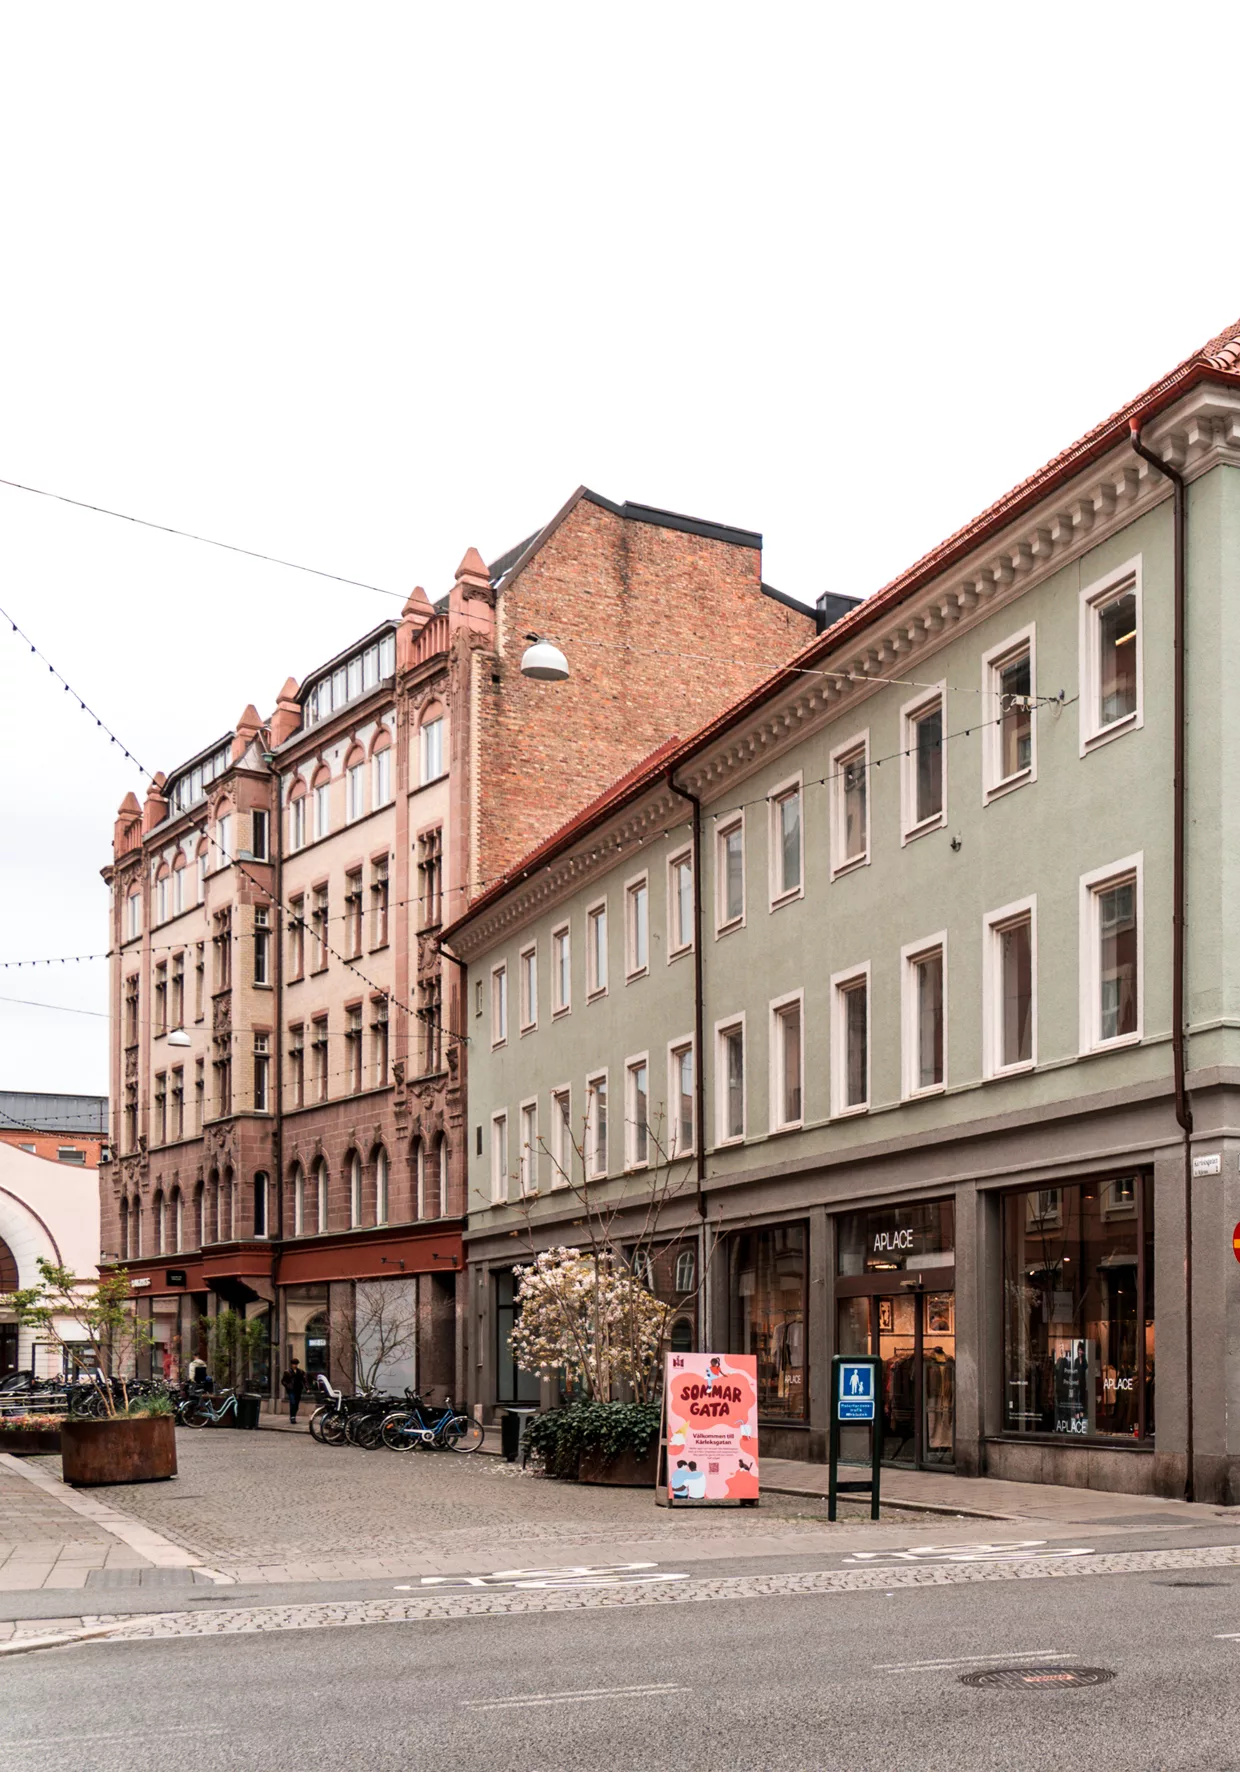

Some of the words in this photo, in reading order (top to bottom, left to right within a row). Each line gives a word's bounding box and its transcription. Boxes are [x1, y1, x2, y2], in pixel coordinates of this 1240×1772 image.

[873, 1229, 914, 1252] APLACE
[784, 1374, 801, 1384] APLACE
[1103, 1378, 1133, 1390] APLACE
[680, 1384, 742, 1402] SOMMAR
[690, 1402, 730, 1417] GATA
[1056, 1420, 1088, 1434] APLACE
